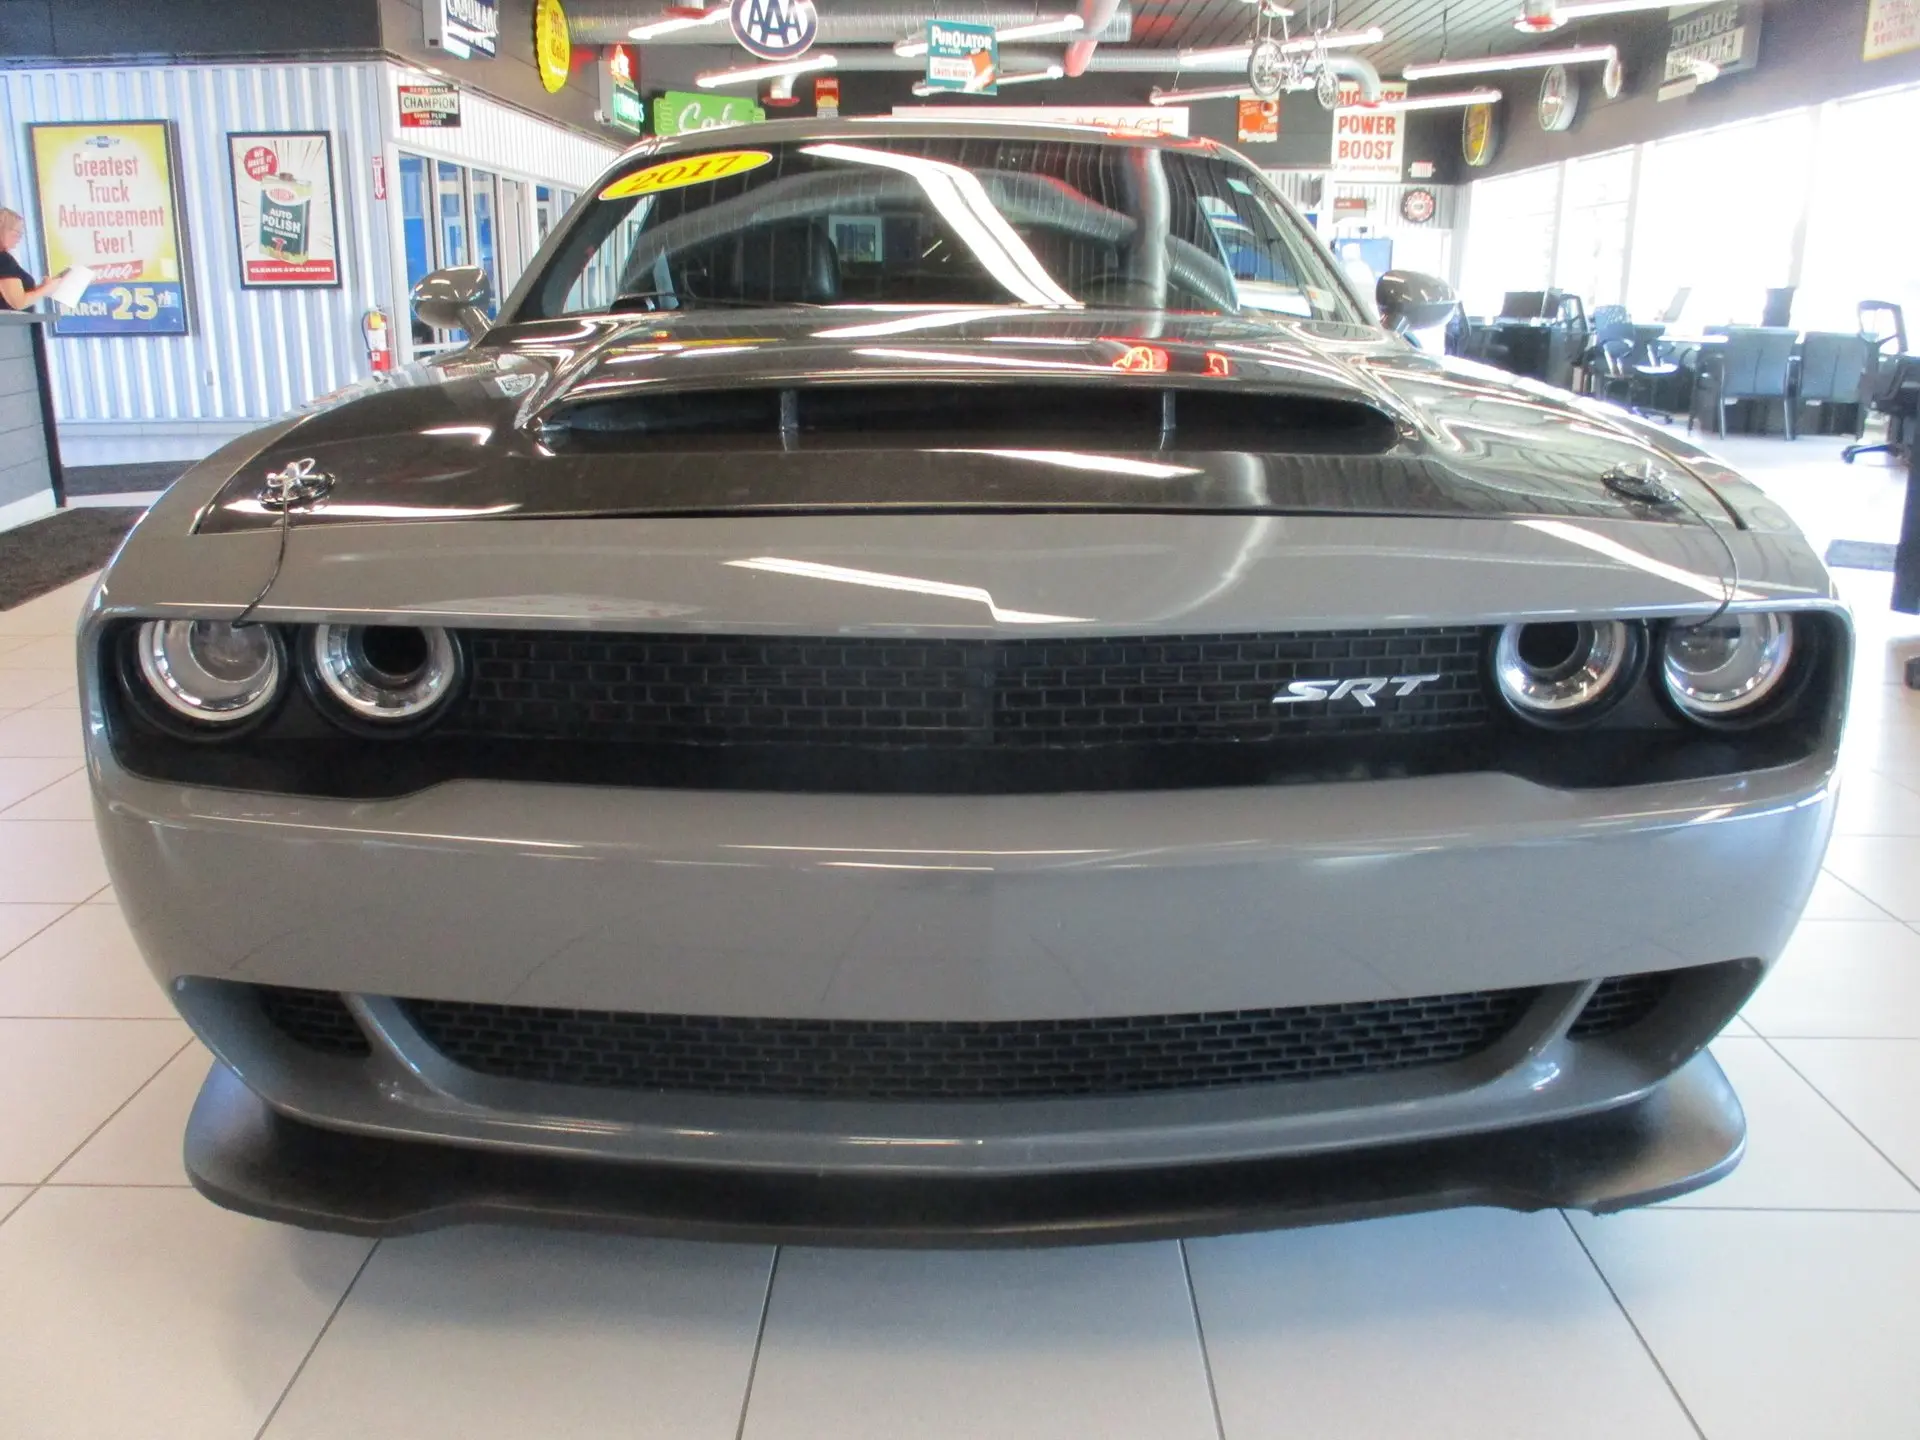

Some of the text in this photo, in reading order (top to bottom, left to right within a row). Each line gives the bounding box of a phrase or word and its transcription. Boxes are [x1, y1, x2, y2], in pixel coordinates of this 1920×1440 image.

[747, 0, 802, 47] AAA
[403, 96, 455, 109] CHAMPION
[1338, 115, 1396, 135] POWER
[1338, 140, 1394, 160] BOOST
[73, 152, 138, 177] Greatest
[624, 154, 742, 194] 2017
[86, 179, 130, 203] Truck
[59, 204, 164, 228] Advancement
[262, 213, 301, 234] POLISH
[270, 208, 292, 219] AUTO
[1272, 674, 1440, 707] SRT
